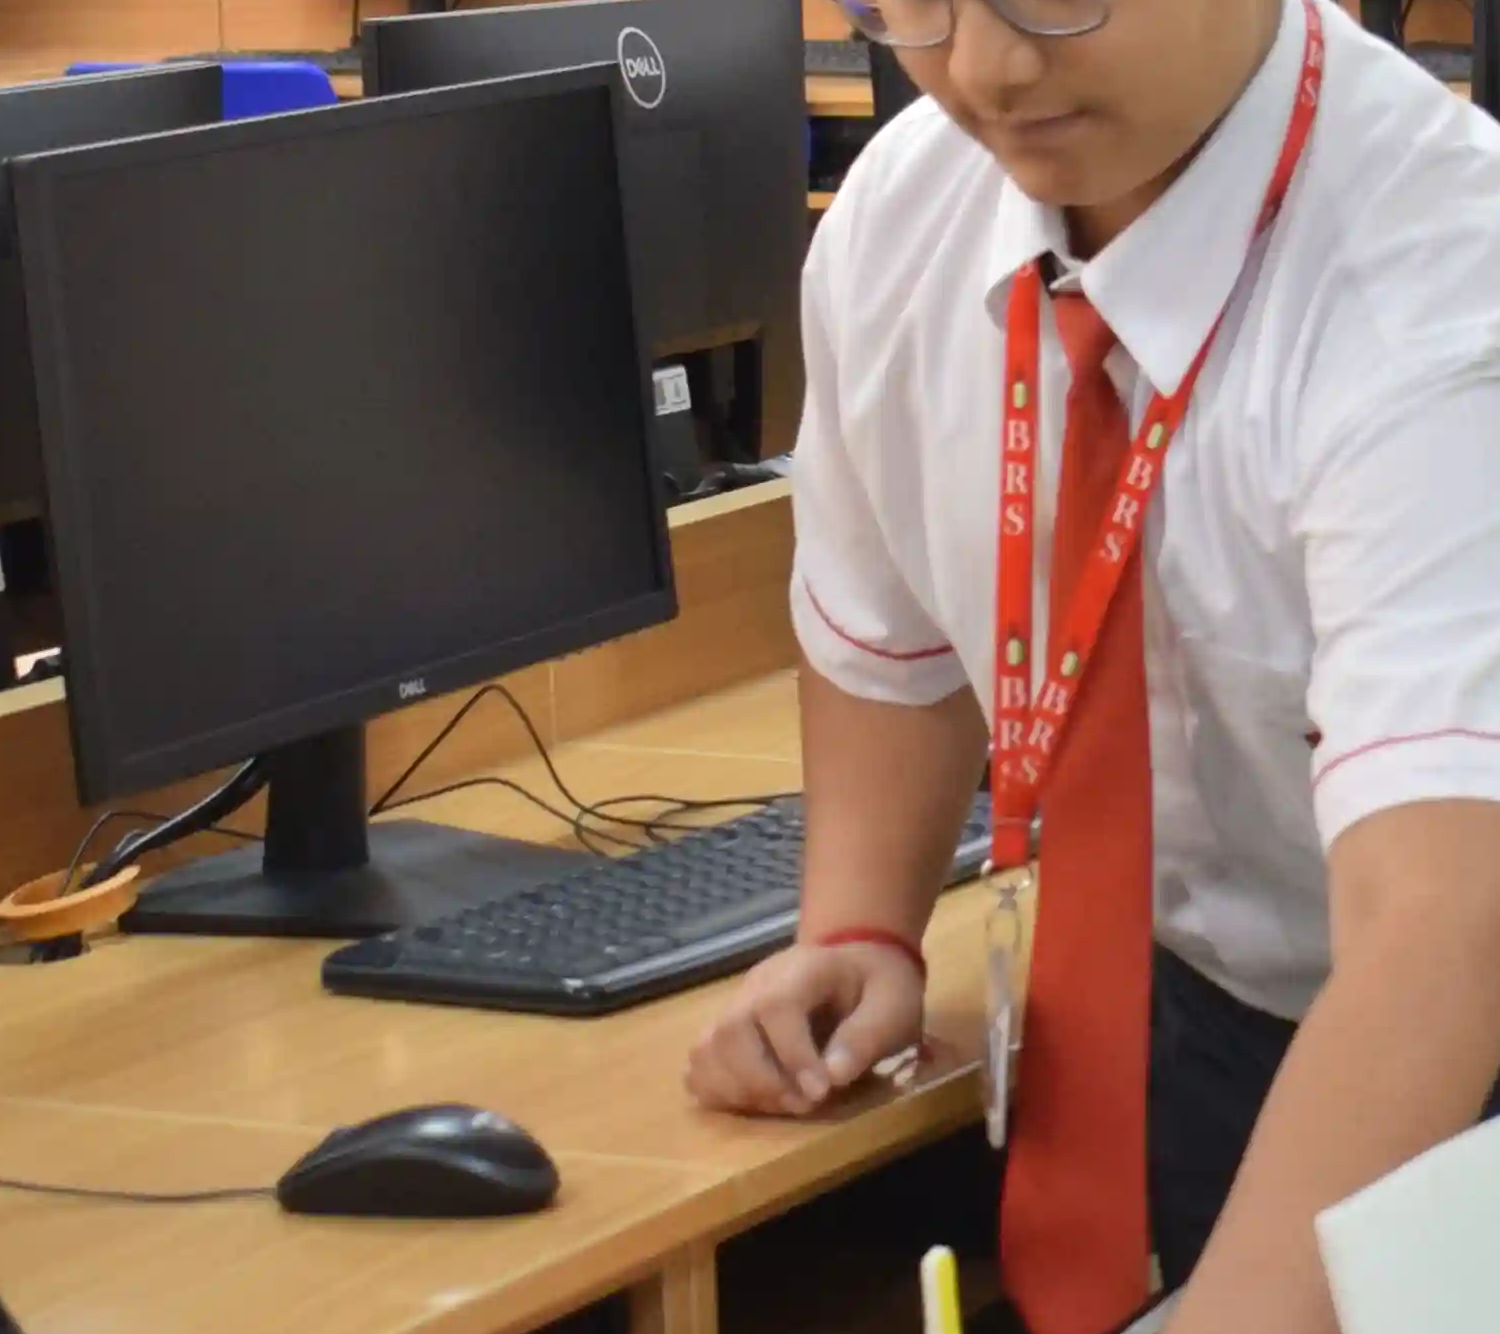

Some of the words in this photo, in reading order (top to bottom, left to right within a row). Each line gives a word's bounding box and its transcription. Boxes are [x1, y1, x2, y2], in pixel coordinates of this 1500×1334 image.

[625, 55, 661, 78] DELL
[1003, 419, 1032, 536] BRS
[1100, 455, 1153, 564] BRS
[1019, 680, 1068, 788] BRS
